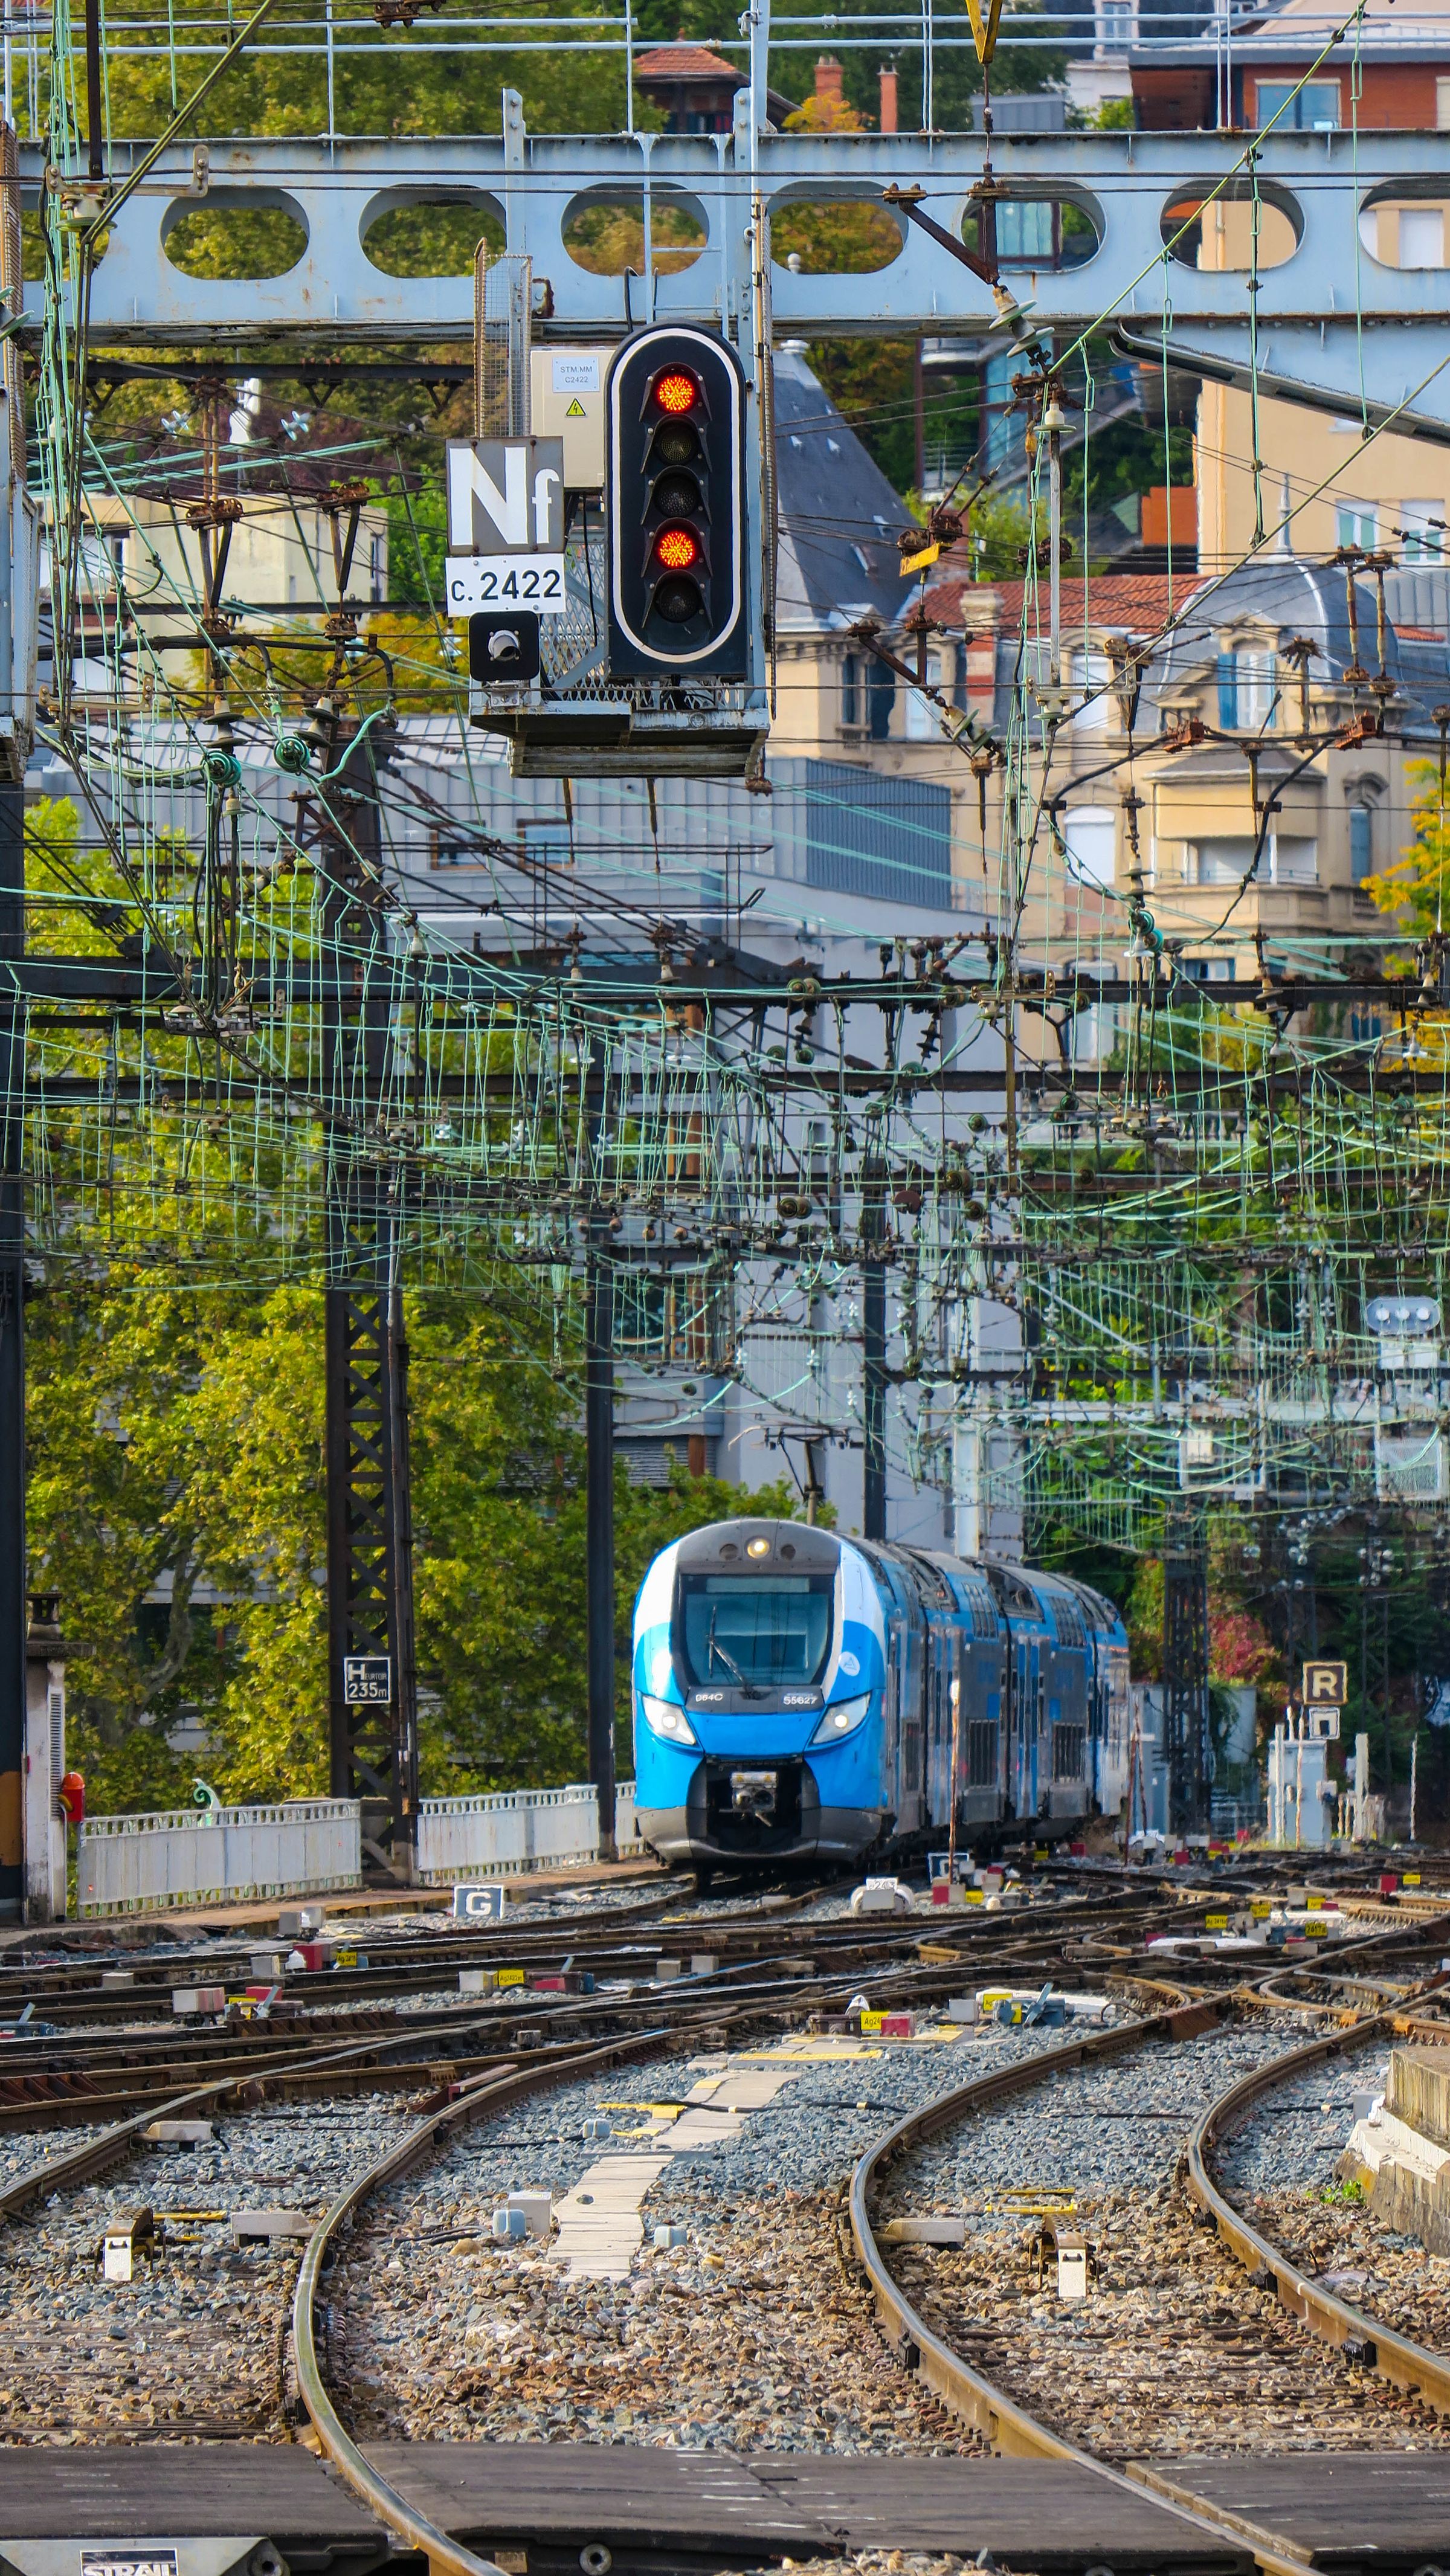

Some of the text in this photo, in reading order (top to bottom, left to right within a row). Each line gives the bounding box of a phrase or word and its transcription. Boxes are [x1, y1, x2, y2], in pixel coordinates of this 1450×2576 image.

[450, 446, 560, 545] Nf
[348, 1682, 387, 1698] 235m
[1312, 1670, 1337, 1698] R
[466, 1892, 492, 1916] G
